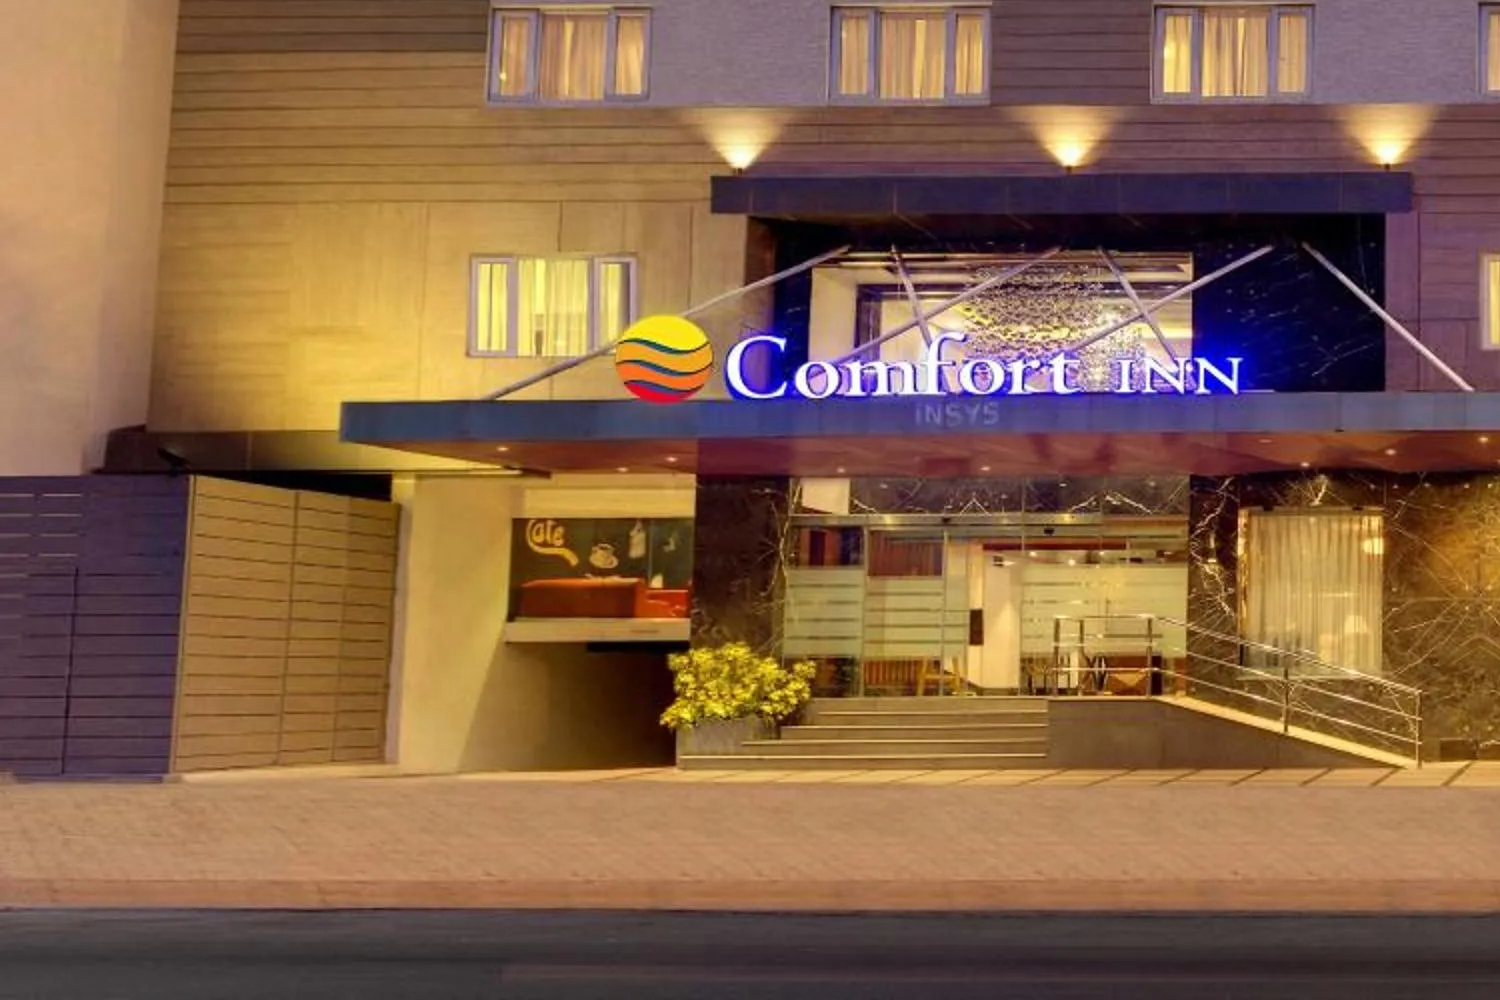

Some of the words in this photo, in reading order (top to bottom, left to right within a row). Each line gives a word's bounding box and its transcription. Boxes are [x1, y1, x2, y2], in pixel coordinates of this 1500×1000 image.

[726, 332, 1081, 399] Comfort
[1113, 356, 1243, 395] INN
[915, 401, 1001, 428] INSYS
